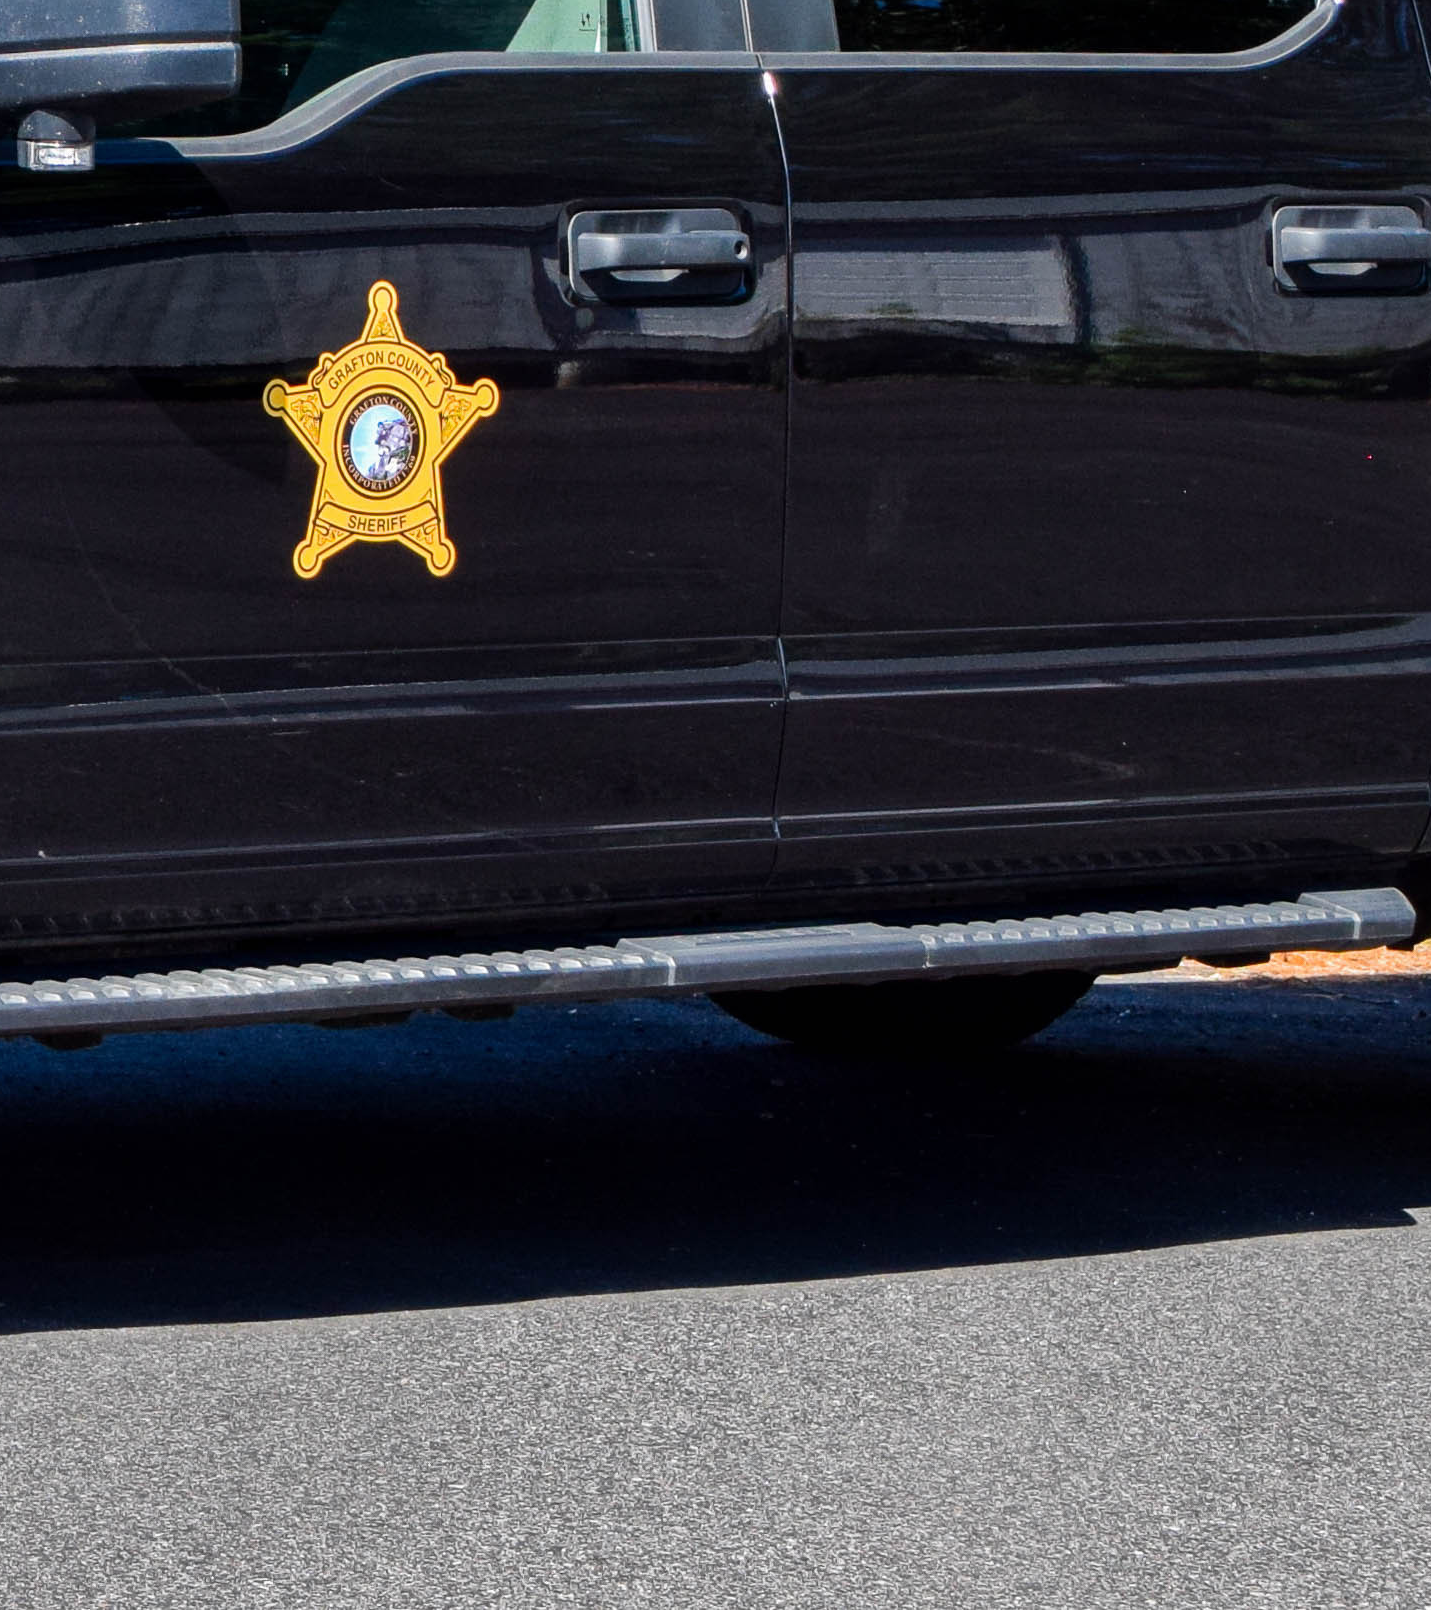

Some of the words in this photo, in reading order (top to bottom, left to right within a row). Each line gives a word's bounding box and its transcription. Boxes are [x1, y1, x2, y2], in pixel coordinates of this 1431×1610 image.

[328, 350, 384, 390] GRAFTON
[387, 352, 435, 388] COUNTY
[349, 396, 389, 425] GRAFTON
[389, 398, 418, 435] COUNTY
[342, 444, 401, 491] INCORPORATED
[347, 514, 407, 532] SHERIFF
